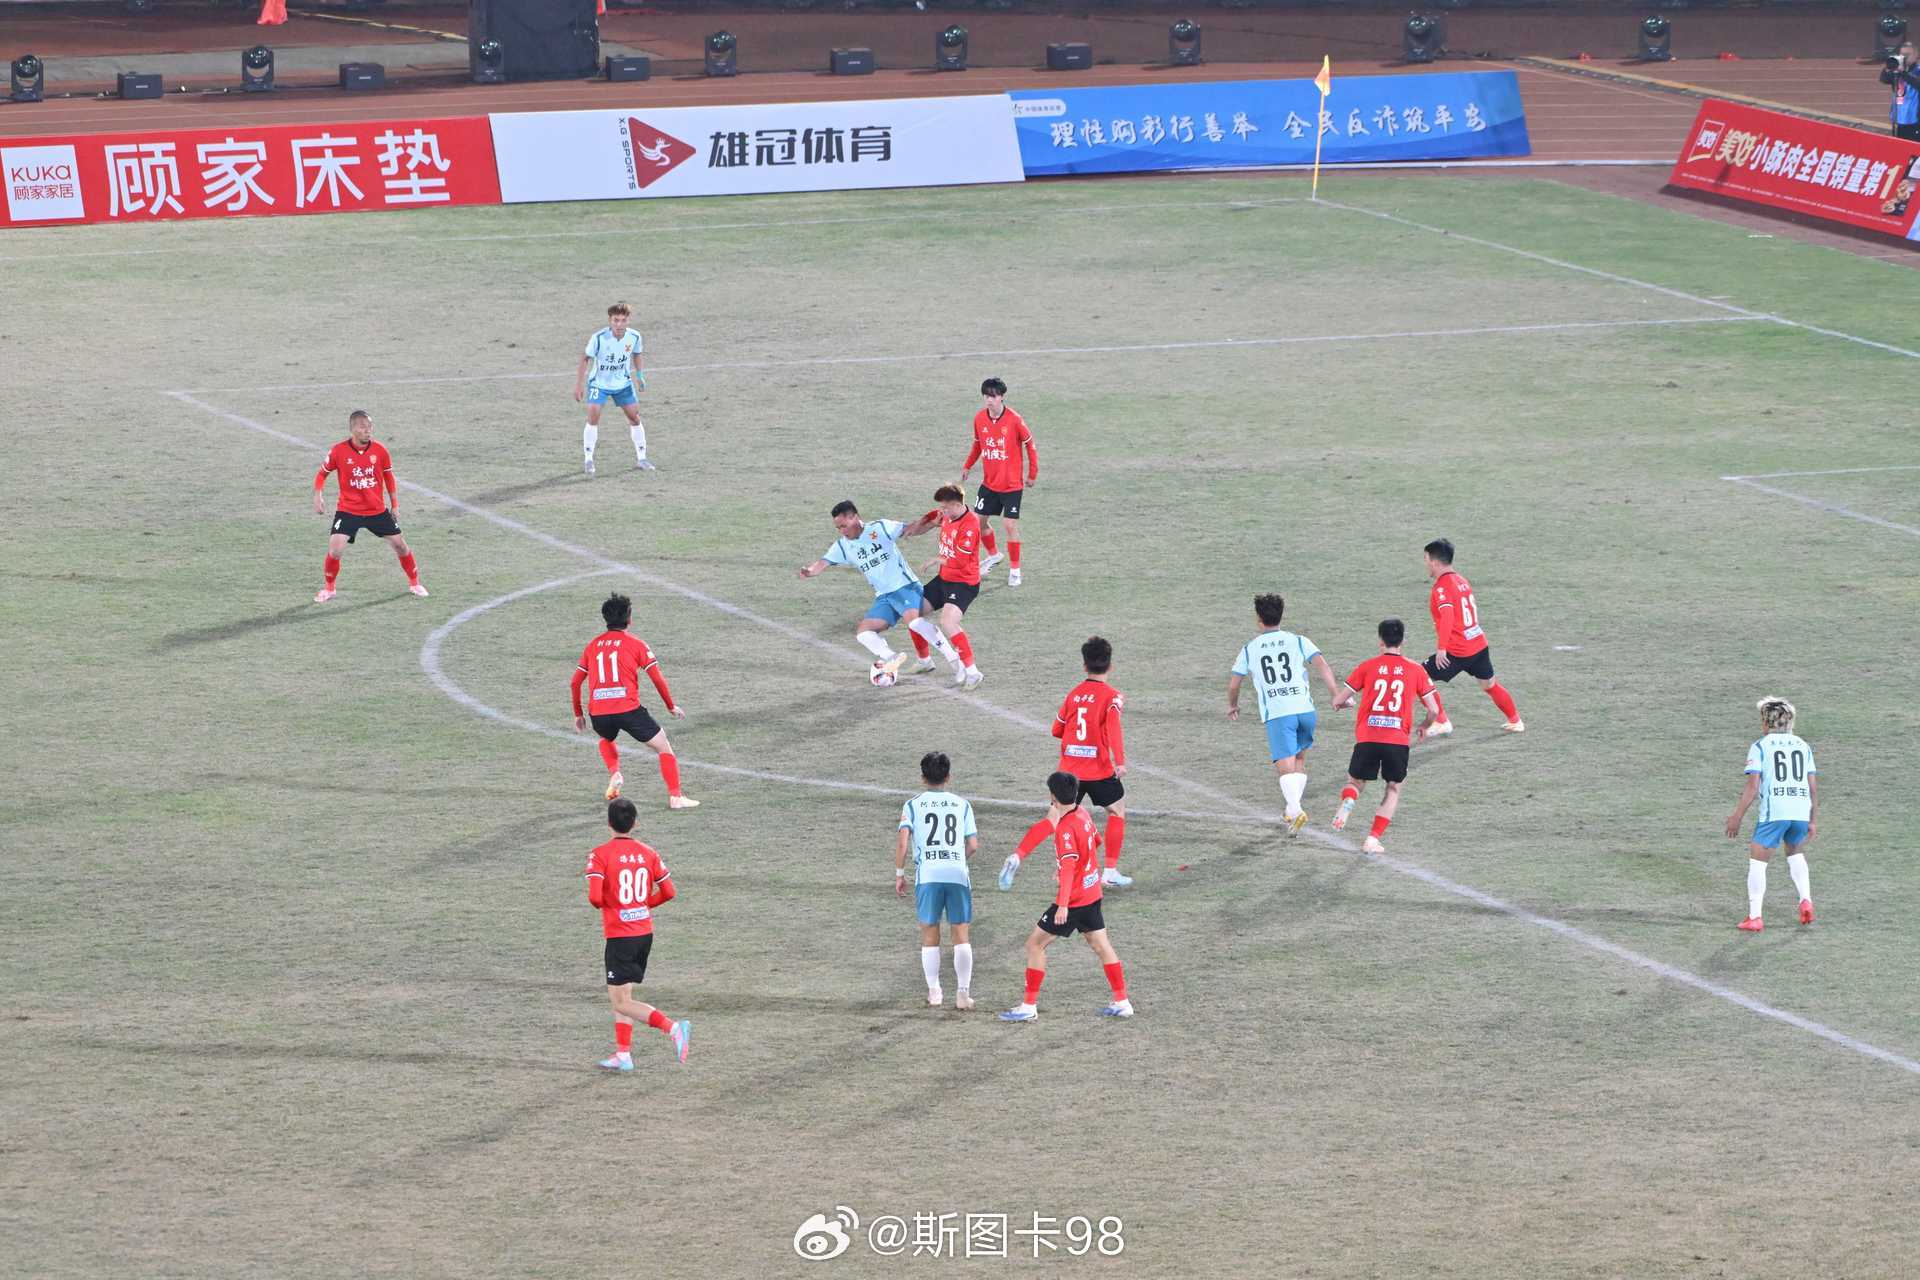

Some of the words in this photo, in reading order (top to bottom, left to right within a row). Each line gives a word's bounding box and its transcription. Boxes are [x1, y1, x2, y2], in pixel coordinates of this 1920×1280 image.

[1050, 111, 1259, 149] 理性购彩行善举
[708, 126, 892, 168] 雄冠体育
[104, 129, 451, 217] 顾家床垫
[622, 140, 636, 190] SPORTS
[14, 183, 74, 201] 顾家家居
[596, 651, 619, 683] 11
[1260, 652, 1292, 685] 63
[1372, 679, 1404, 712] 23
[1076, 707, 1088, 741] 5
[1774, 750, 1804, 782] 60
[1773, 786, 1808, 797] 好医生
[925, 812, 957, 846] 28
[925, 850, 961, 861] 好医生
[619, 867, 649, 905] 80
